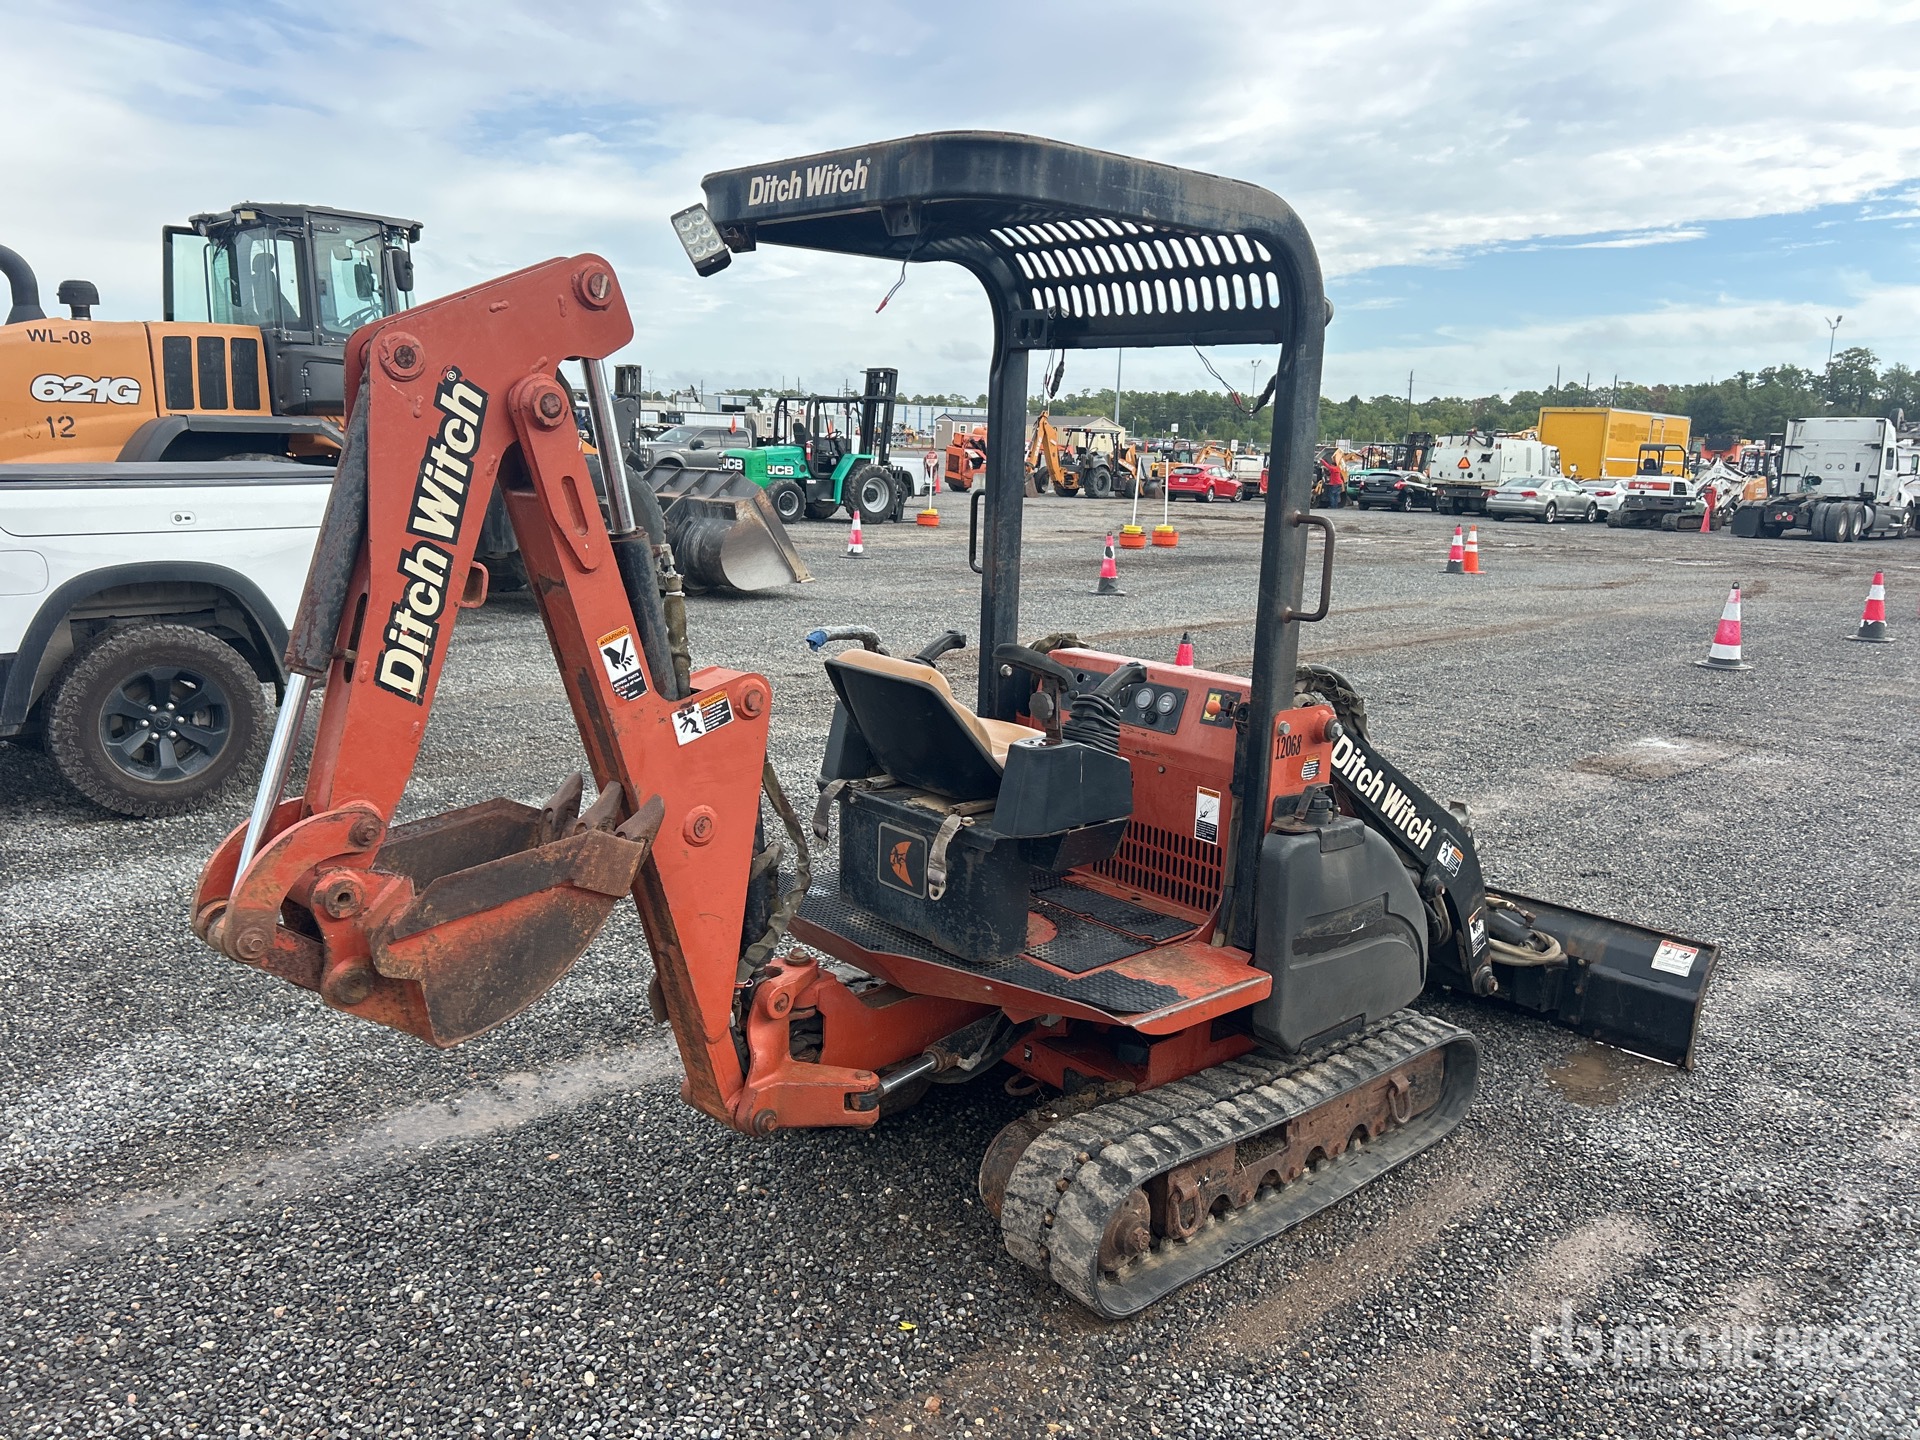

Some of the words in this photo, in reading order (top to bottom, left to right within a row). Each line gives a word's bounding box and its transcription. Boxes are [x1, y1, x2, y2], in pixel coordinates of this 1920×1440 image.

[748, 171, 802, 206] Ditch
[26, 328, 92, 345] WL-08
[30, 374, 141, 405] 621G
[722, 458, 743, 471] JCB
[768, 465, 794, 475] JCB
[379, 546, 448, 698] Ditch
[1275, 734, 1303, 760] 12068
[1331, 733, 1385, 804] Ditch
